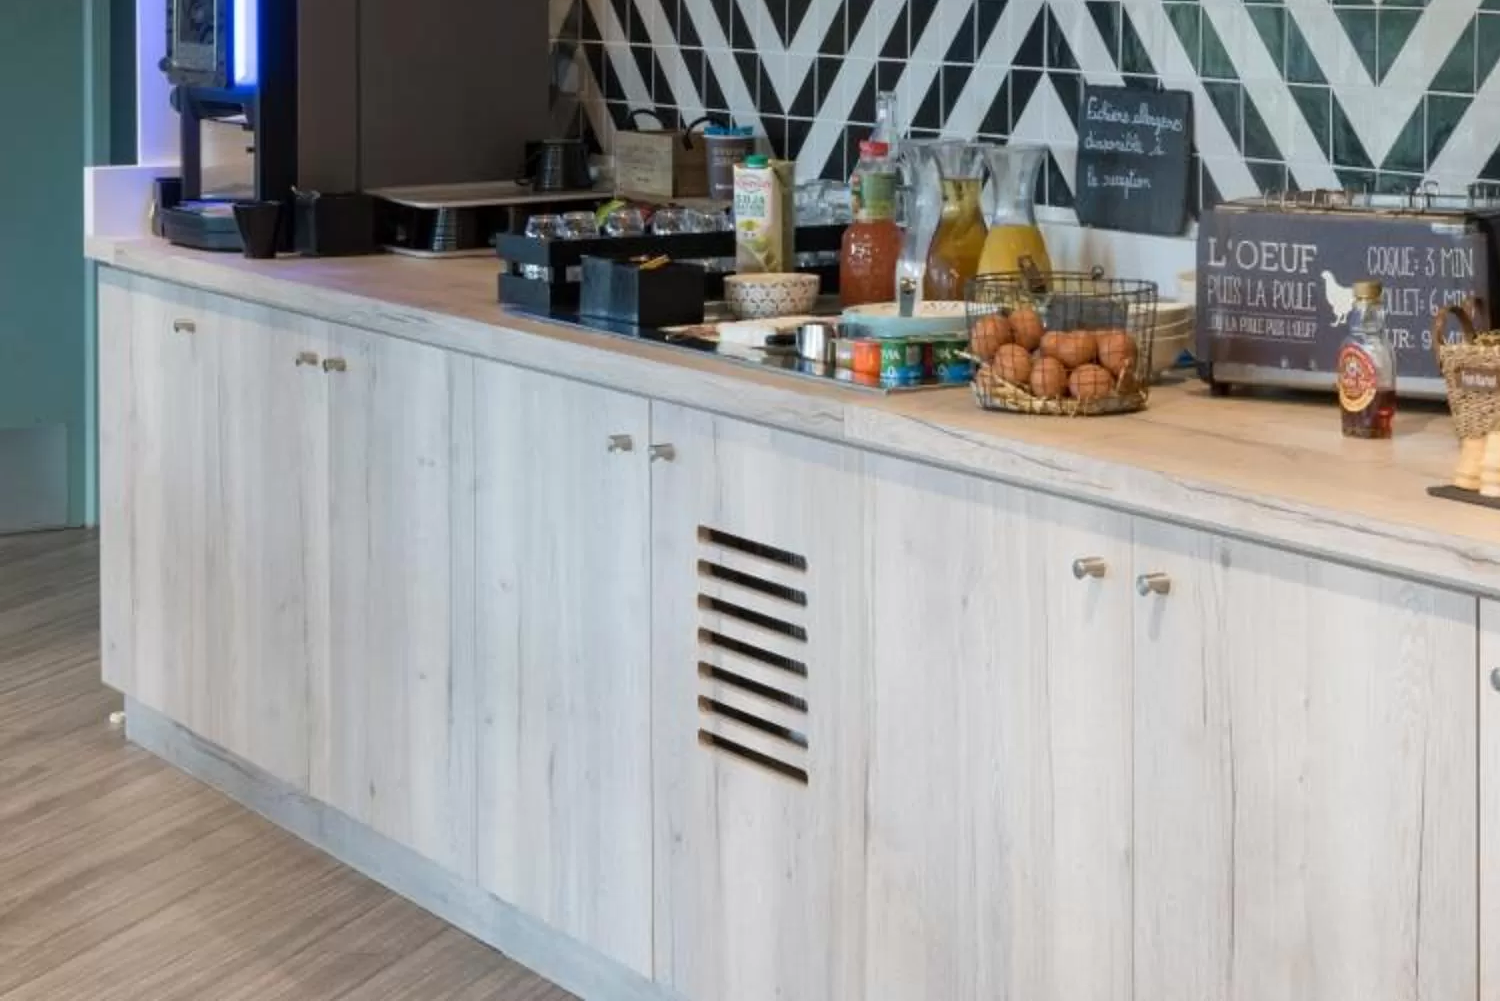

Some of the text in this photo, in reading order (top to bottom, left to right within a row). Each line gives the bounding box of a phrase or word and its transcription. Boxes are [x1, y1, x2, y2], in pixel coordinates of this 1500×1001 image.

[1207, 237, 1318, 274] L'OEUF
[1424, 247, 1436, 277] 3
[1440, 247, 1475, 278] MIN
[1247, 278, 1267, 308] LA
[1272, 279, 1318, 312] POULE
[1429, 287, 1439, 317] 6
[1384, 328, 1416, 349] UR:
[1421, 329, 1433, 351] 9
